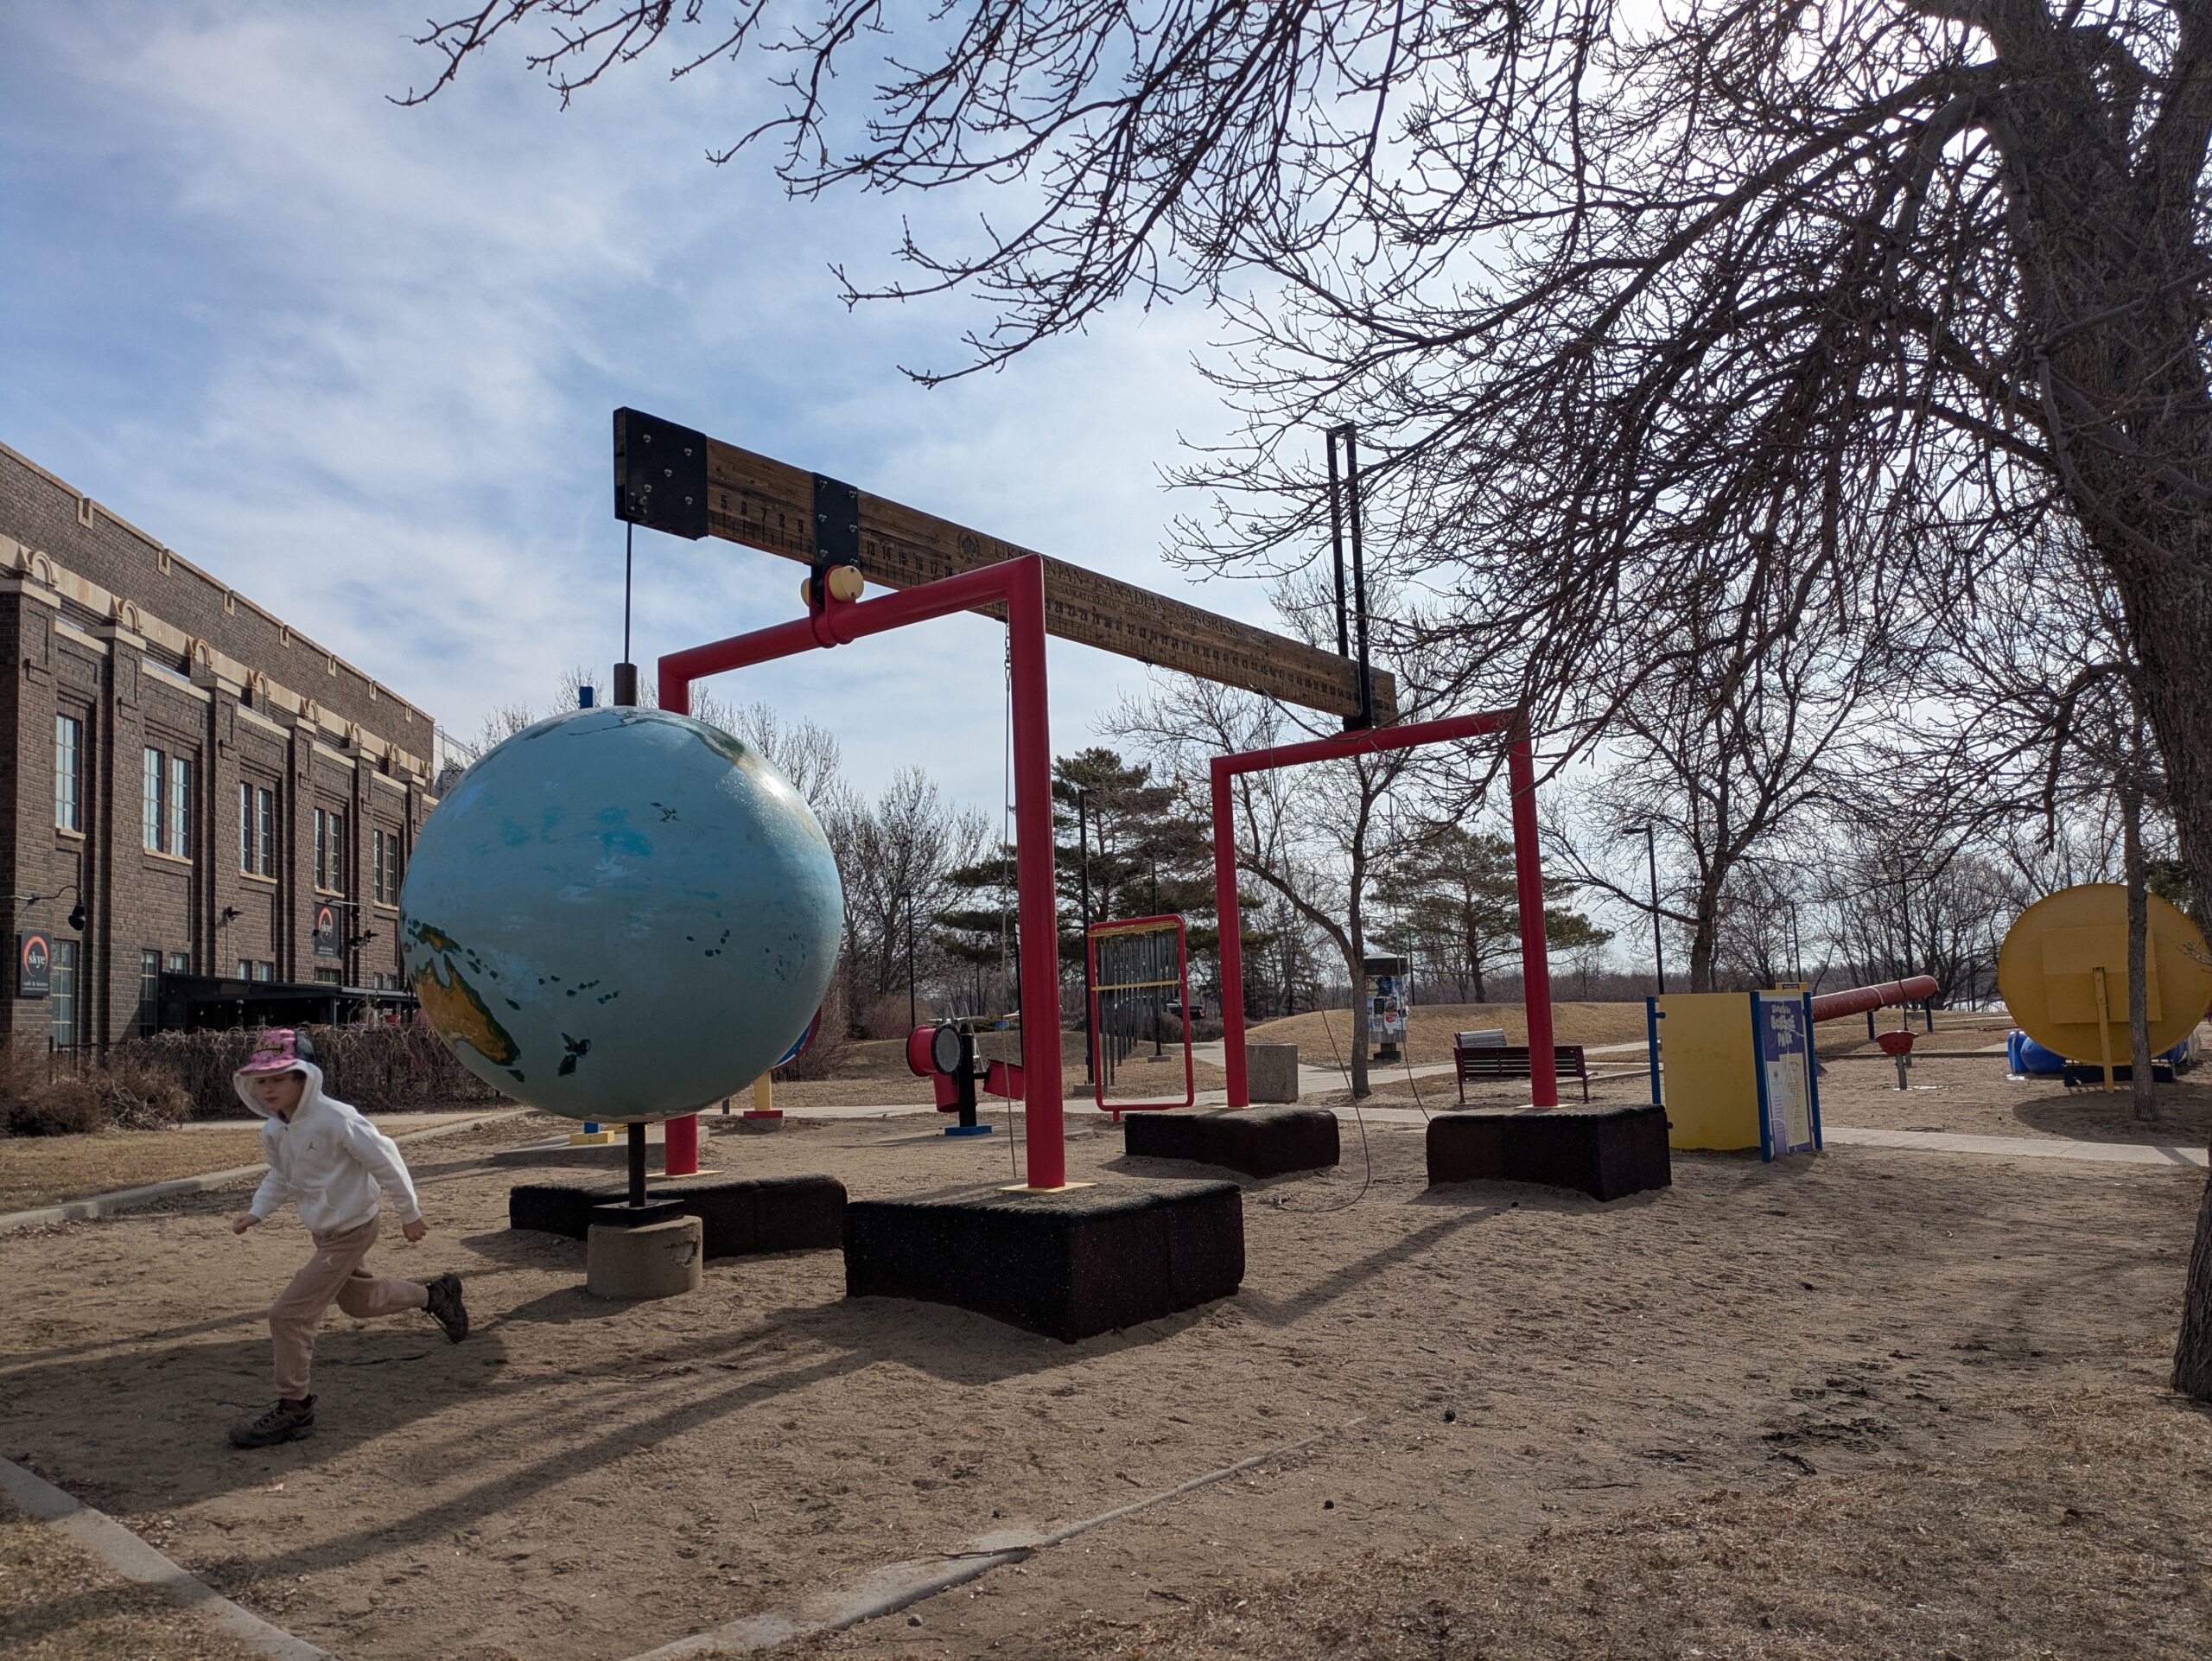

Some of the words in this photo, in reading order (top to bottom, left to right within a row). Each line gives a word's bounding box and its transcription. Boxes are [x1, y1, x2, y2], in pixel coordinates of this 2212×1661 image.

[721, 494, 728, 510] 5
[741, 501, 747, 515] 6
[761, 507, 767, 522] 7
[779, 513, 785, 528] 8
[798, 519, 804, 533] 9
[867, 540, 875, 557] 13
[882, 546, 892, 561] 14
[899, 551, 907, 566] 15
[916, 556, 924, 571] 16
[930, 561, 938, 576] 17
[1092, 612, 1100, 626] 29
[1127, 622, 1135, 636] 32
[1059, 587, 1120, 609] SASKATCHEWAN
[1124, 607, 1163, 624] PROVINCIAL
[1094, 577, 1168, 614] CANADIAN
[1176, 605, 1238, 638] CONGRESS
[29, 951, 46, 968] skye
